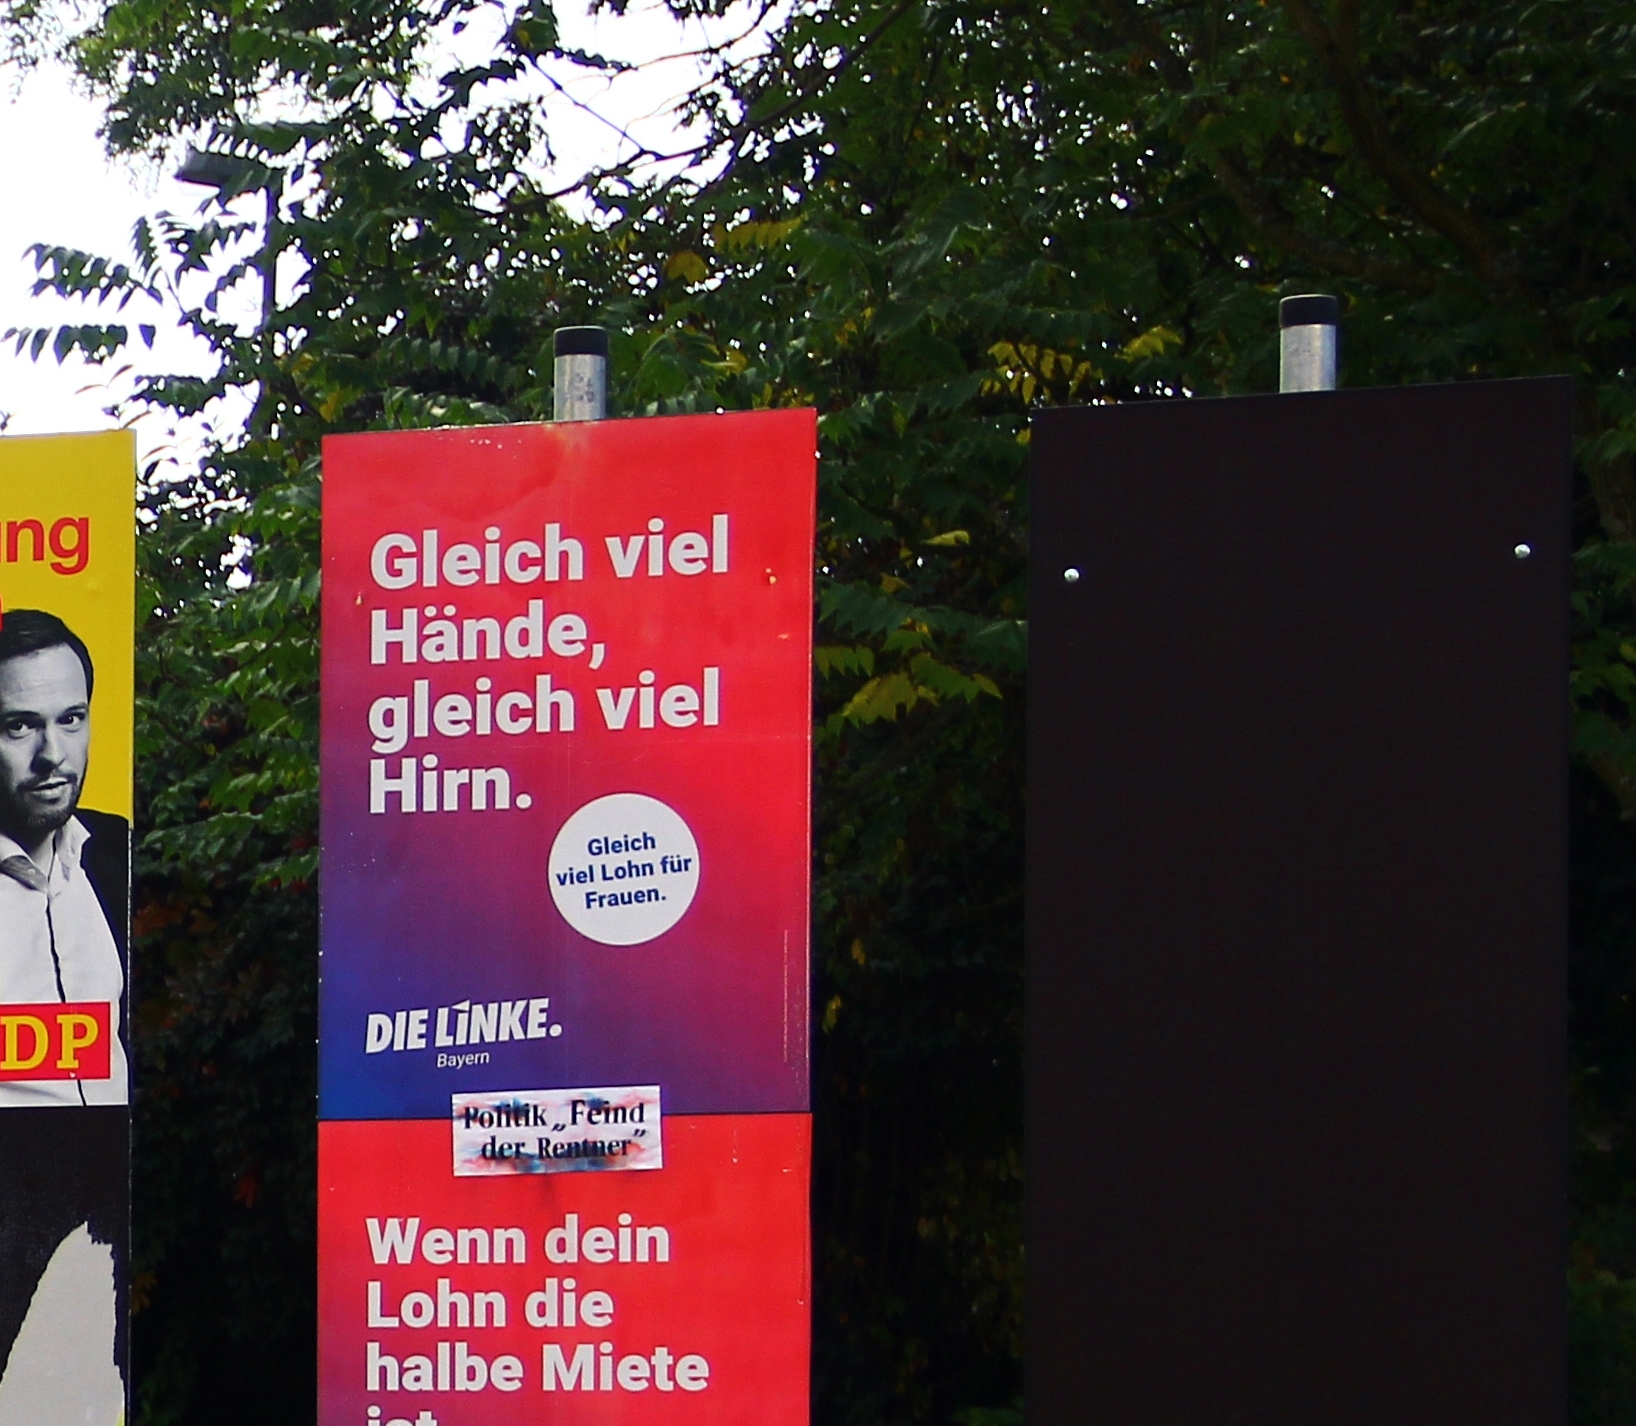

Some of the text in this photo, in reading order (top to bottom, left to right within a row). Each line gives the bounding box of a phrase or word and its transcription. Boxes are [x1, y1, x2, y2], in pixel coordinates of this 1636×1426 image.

[371, 514, 728, 590] Gleich viel
[370, 599, 605, 670] Hände,
[368, 667, 720, 754] gleich viel
[369, 752, 533, 814] Hirn.
[588, 833, 656, 856] Gleich
[556, 854, 692, 888] viel Lohn für
[585, 885, 667, 909] Frauen.
[366, 1010, 427, 1052] DIE
[436, 1049, 490, 1069] Bayern
[463, 1104, 548, 1132] Politik
[481, 1135, 526, 1162] der
[366, 1214, 670, 1265] Wenn dein
[368, 1279, 614, 1328] Lohn die
[367, 1342, 710, 1393] halbe Miete
